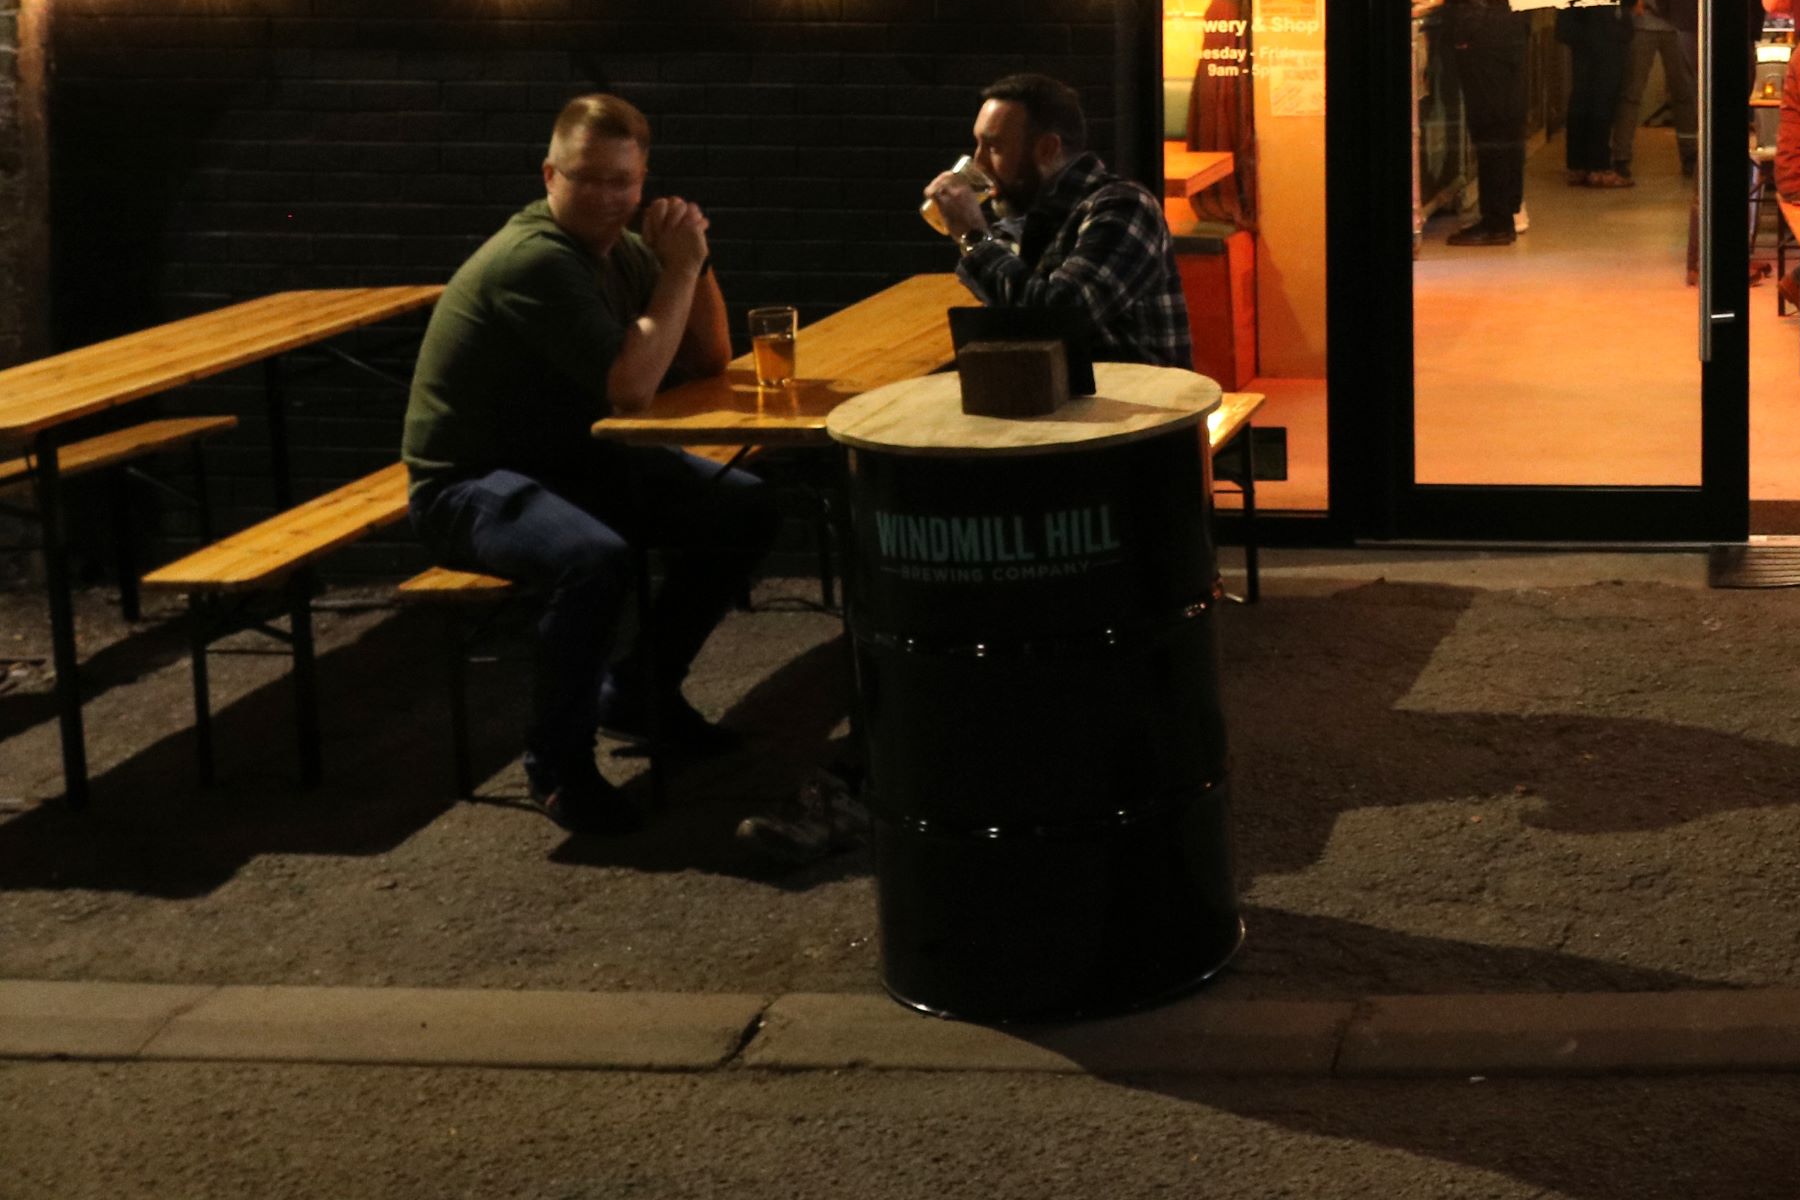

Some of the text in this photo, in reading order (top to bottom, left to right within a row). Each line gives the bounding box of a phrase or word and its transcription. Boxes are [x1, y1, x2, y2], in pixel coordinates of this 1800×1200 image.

[1207, 63, 1239, 77] 9am
[875, 504, 1121, 563] WINDMILL HILL
[900, 560, 1090, 583] BREWING COMPANY
